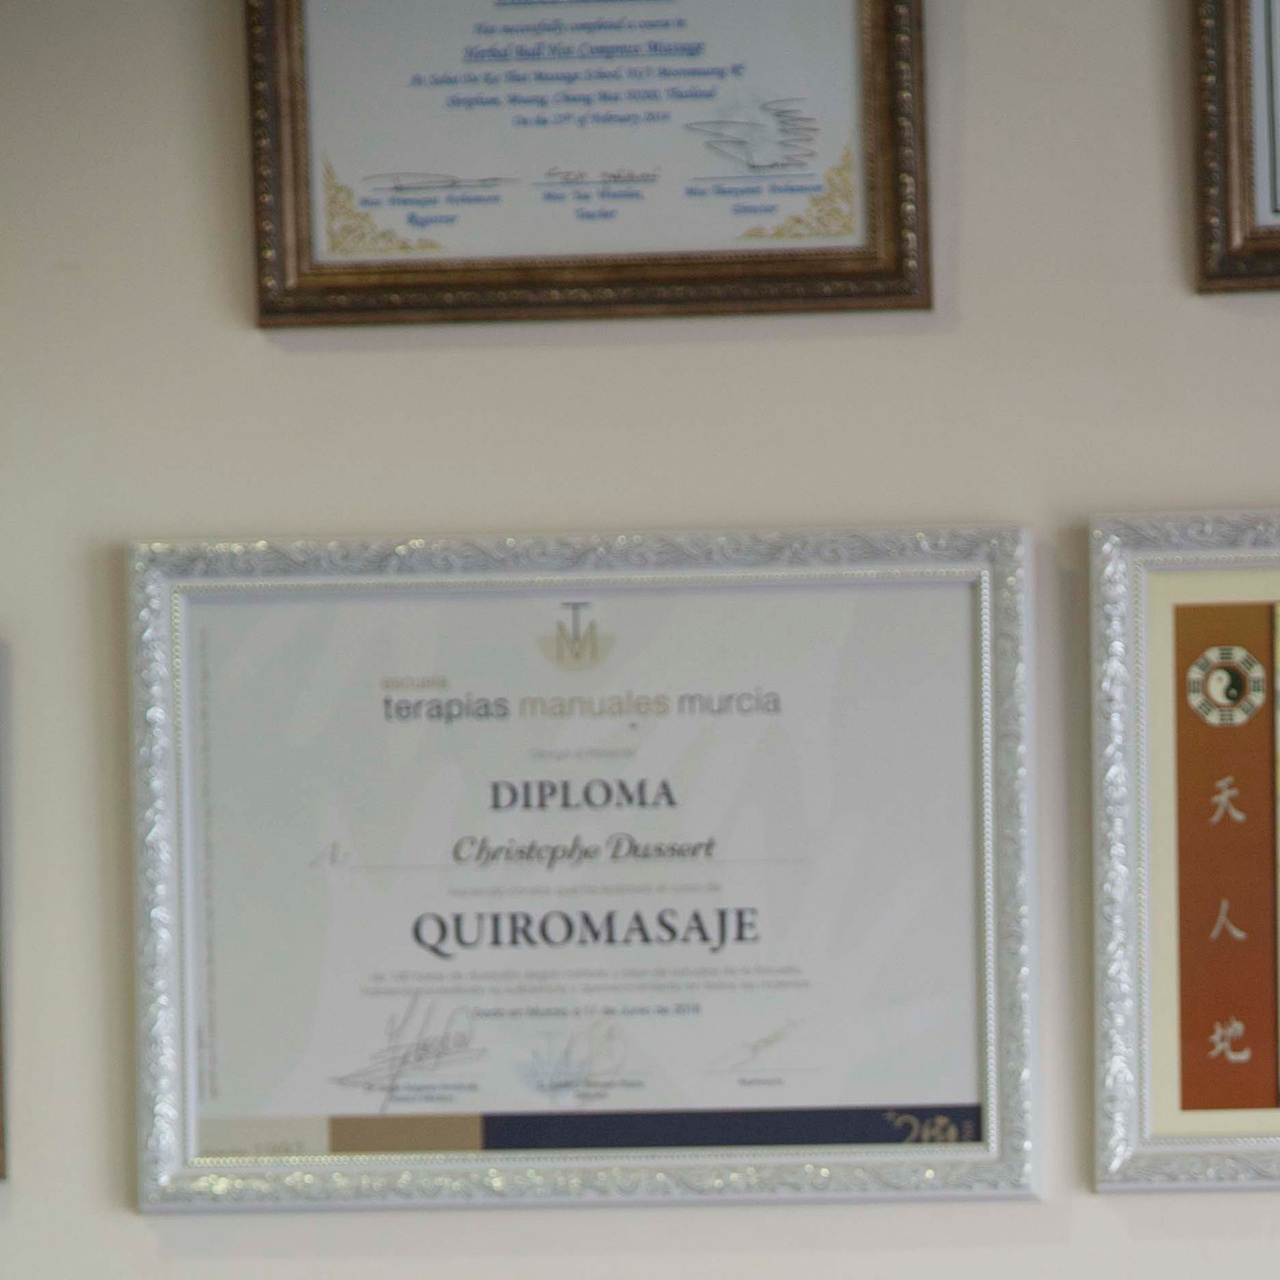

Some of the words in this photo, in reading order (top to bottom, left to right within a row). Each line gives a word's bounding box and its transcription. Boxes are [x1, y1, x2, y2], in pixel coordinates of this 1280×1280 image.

[383, 693, 512, 724] terapias
[518, 690, 671, 718] manuales
[677, 685, 782, 717] murcia
[490, 778, 677, 810] DIPLOMA
[604, 832, 716, 862] Dussert
[411, 908, 761, 962] QUIROMASAJE
